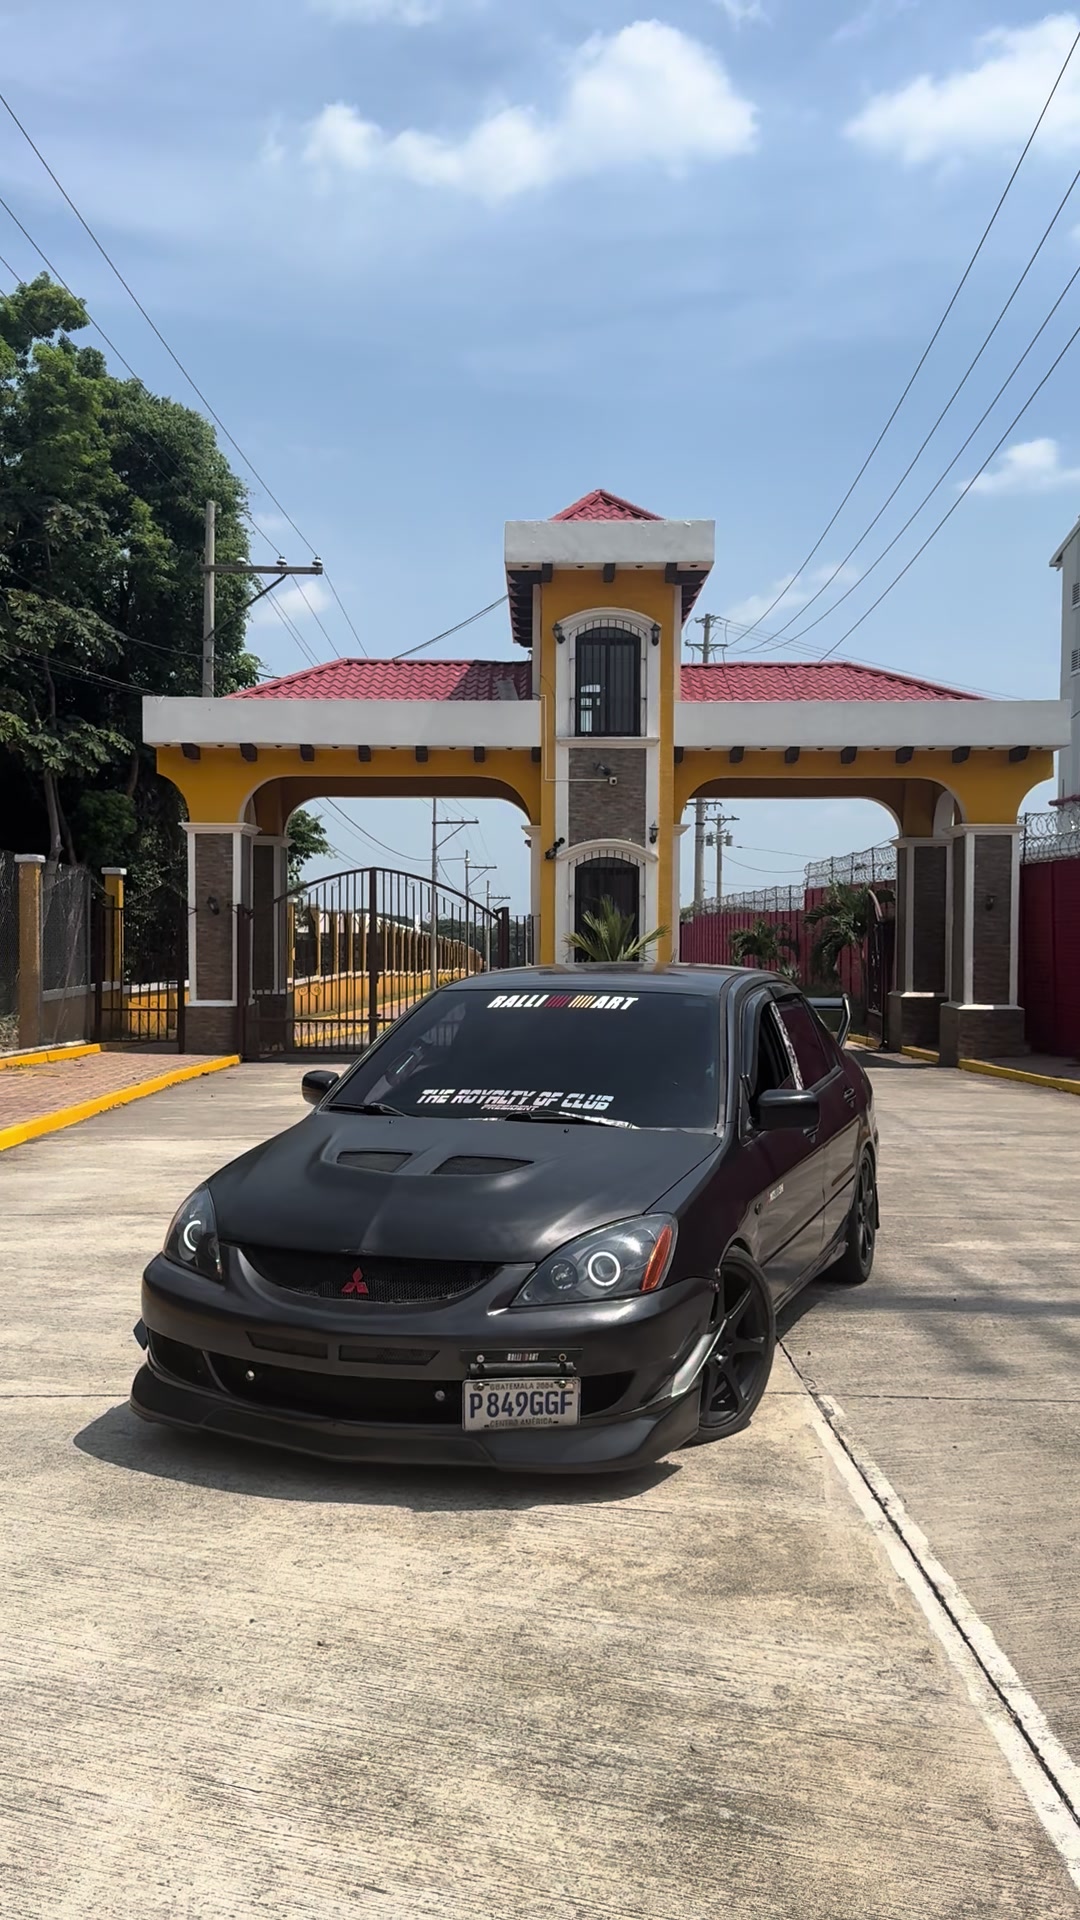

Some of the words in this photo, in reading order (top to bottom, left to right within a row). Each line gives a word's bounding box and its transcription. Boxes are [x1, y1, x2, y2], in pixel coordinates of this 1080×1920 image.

[487, 994, 549, 1008] RALLI
[589, 995, 639, 1010] ART
[417, 1089, 455, 1104] THE
[451, 1089, 537, 1105] ROYALTY
[533, 1091, 564, 1107] OF
[561, 1093, 614, 1111] CLUB
[480, 1103, 540, 1112] PRESIDENT
[489, 1382, 534, 1391] GUATEMALA
[469, 1391, 574, 1418] P849GGF
[489, 1419, 519, 1428] CENTRO
